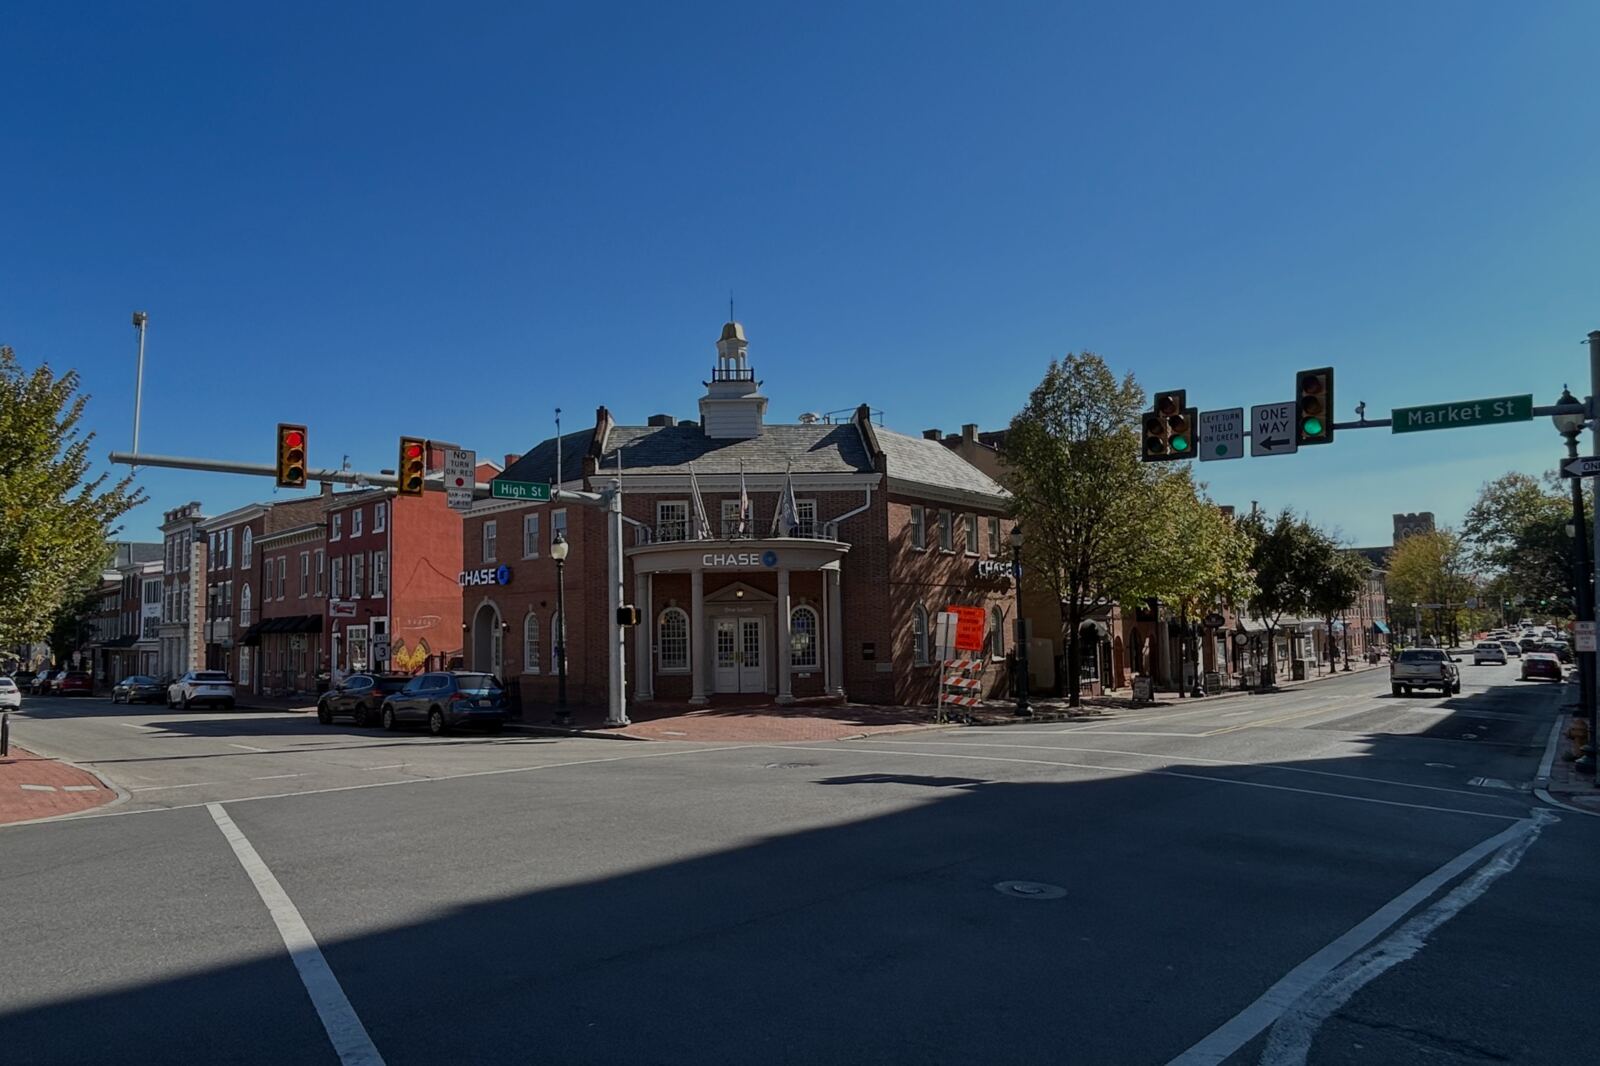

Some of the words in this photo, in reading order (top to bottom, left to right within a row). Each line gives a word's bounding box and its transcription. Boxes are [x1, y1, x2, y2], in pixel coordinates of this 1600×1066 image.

[1203, 414, 1219, 424] LEFT
[1222, 412, 1240, 422] TURN
[1260, 407, 1288, 421] ONE
[1408, 404, 1481, 425] Market
[1493, 400, 1514, 417] St
[1210, 423, 1233, 432] YIELD
[1258, 421, 1289, 434] WAY
[1217, 433, 1239, 442] GREEN
[453, 451, 467, 460] NO
[1584, 462, 1600, 470] ON
[501, 484, 526, 498] High
[531, 486, 542, 497] St
[702, 554, 760, 566] CHASE
[457, 569, 496, 586] CHASE
[379, 647, 386, 657] 3
